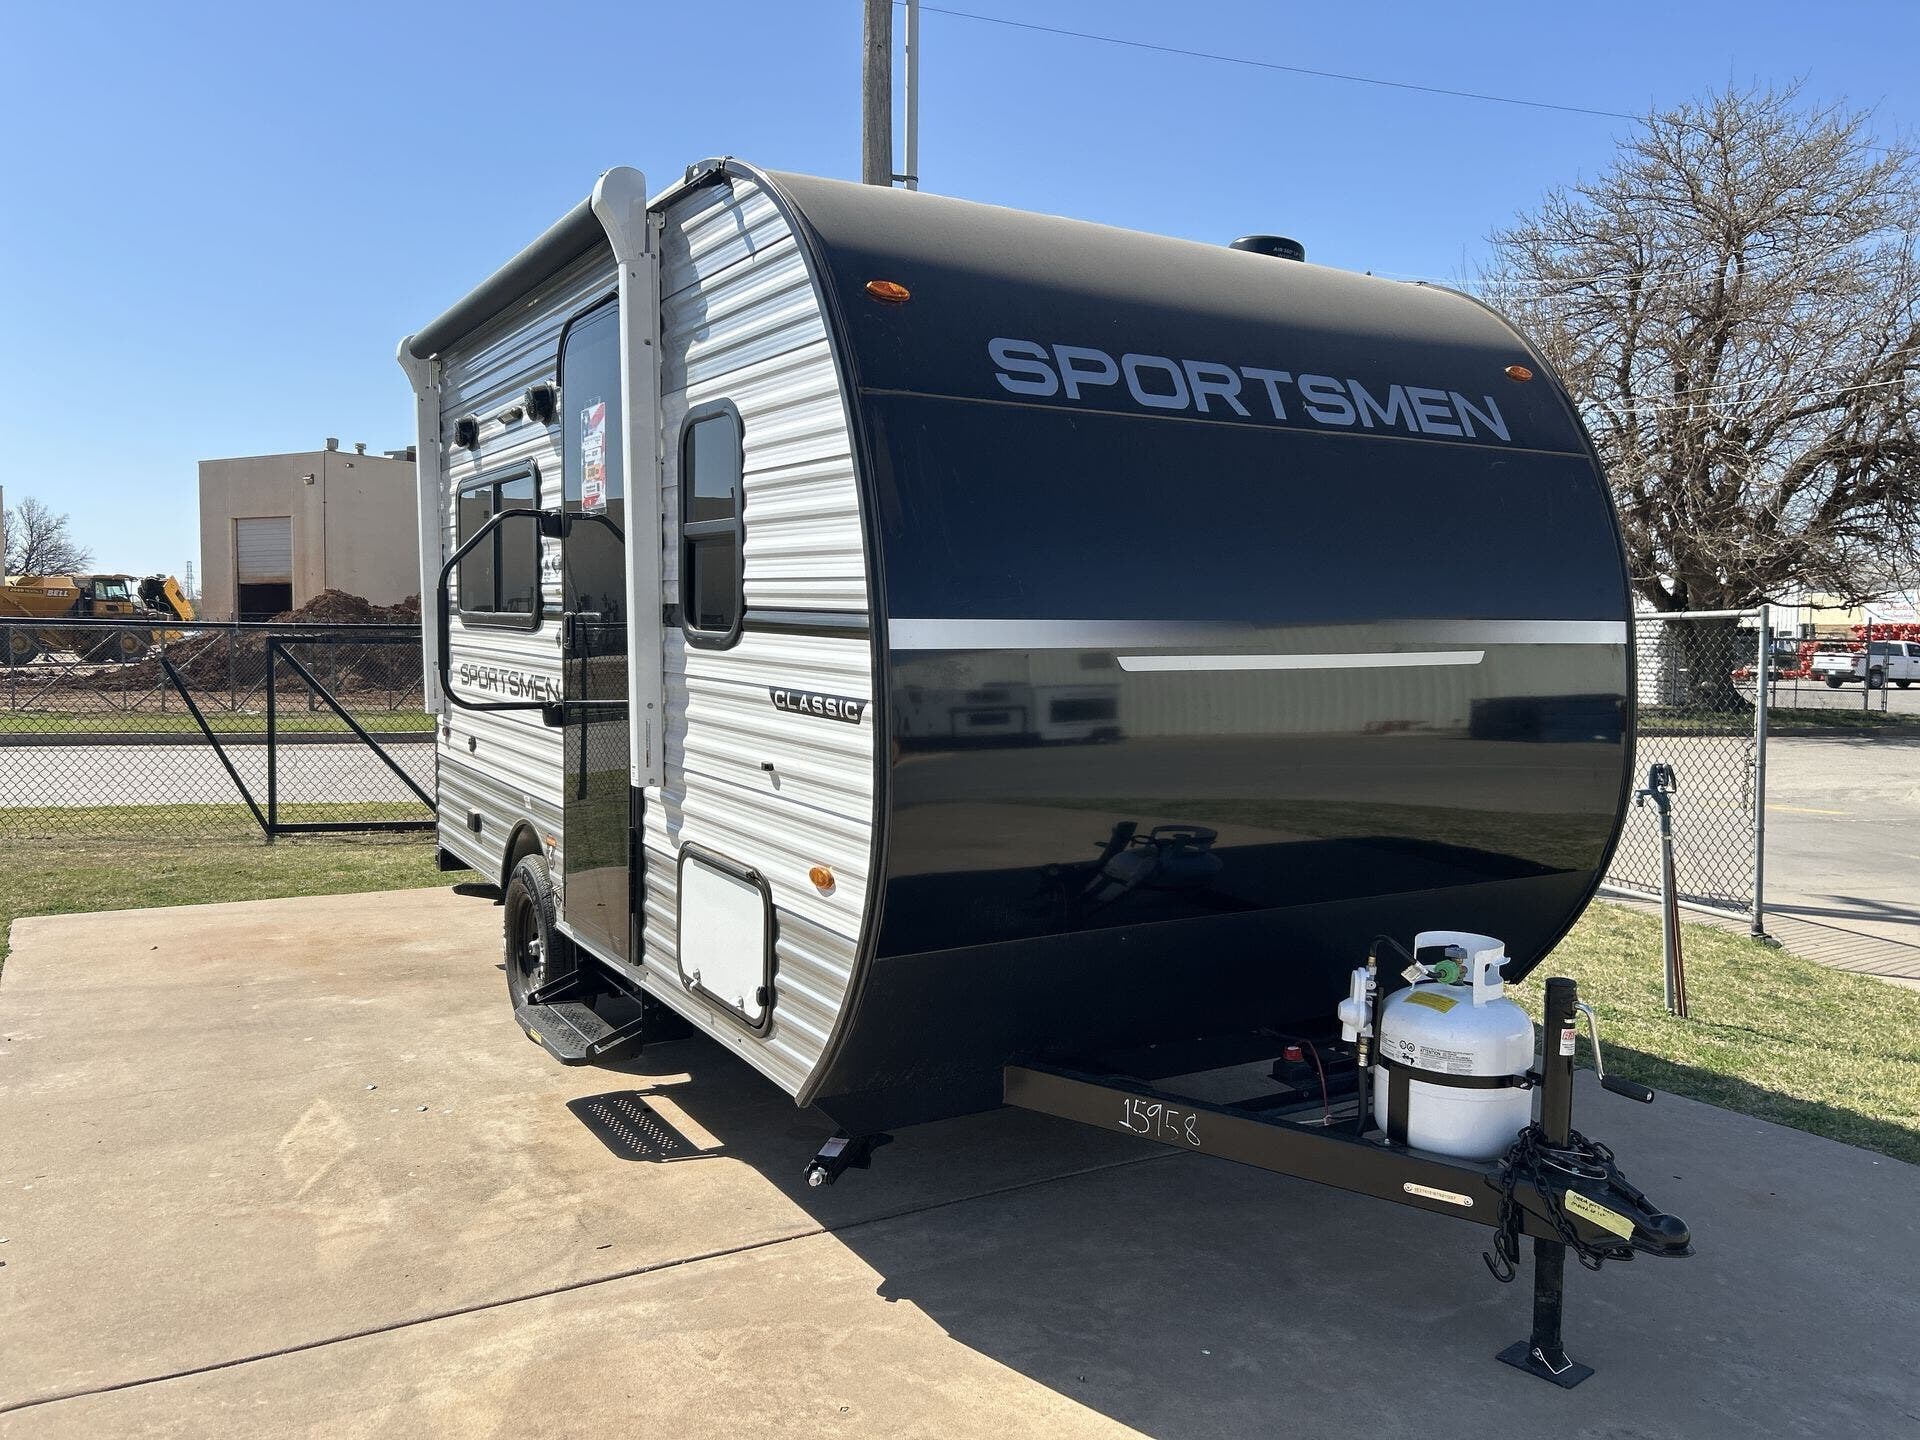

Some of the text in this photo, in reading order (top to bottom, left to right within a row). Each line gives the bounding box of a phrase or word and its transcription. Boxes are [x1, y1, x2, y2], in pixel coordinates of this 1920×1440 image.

[987, 337, 1512, 442] SPORTSMEN
[47, 589, 69, 597] BELL
[460, 663, 560, 701] SPORTSMEN
[774, 690, 858, 721] CLASSIC
[1118, 1098, 1201, 1146] 15958
